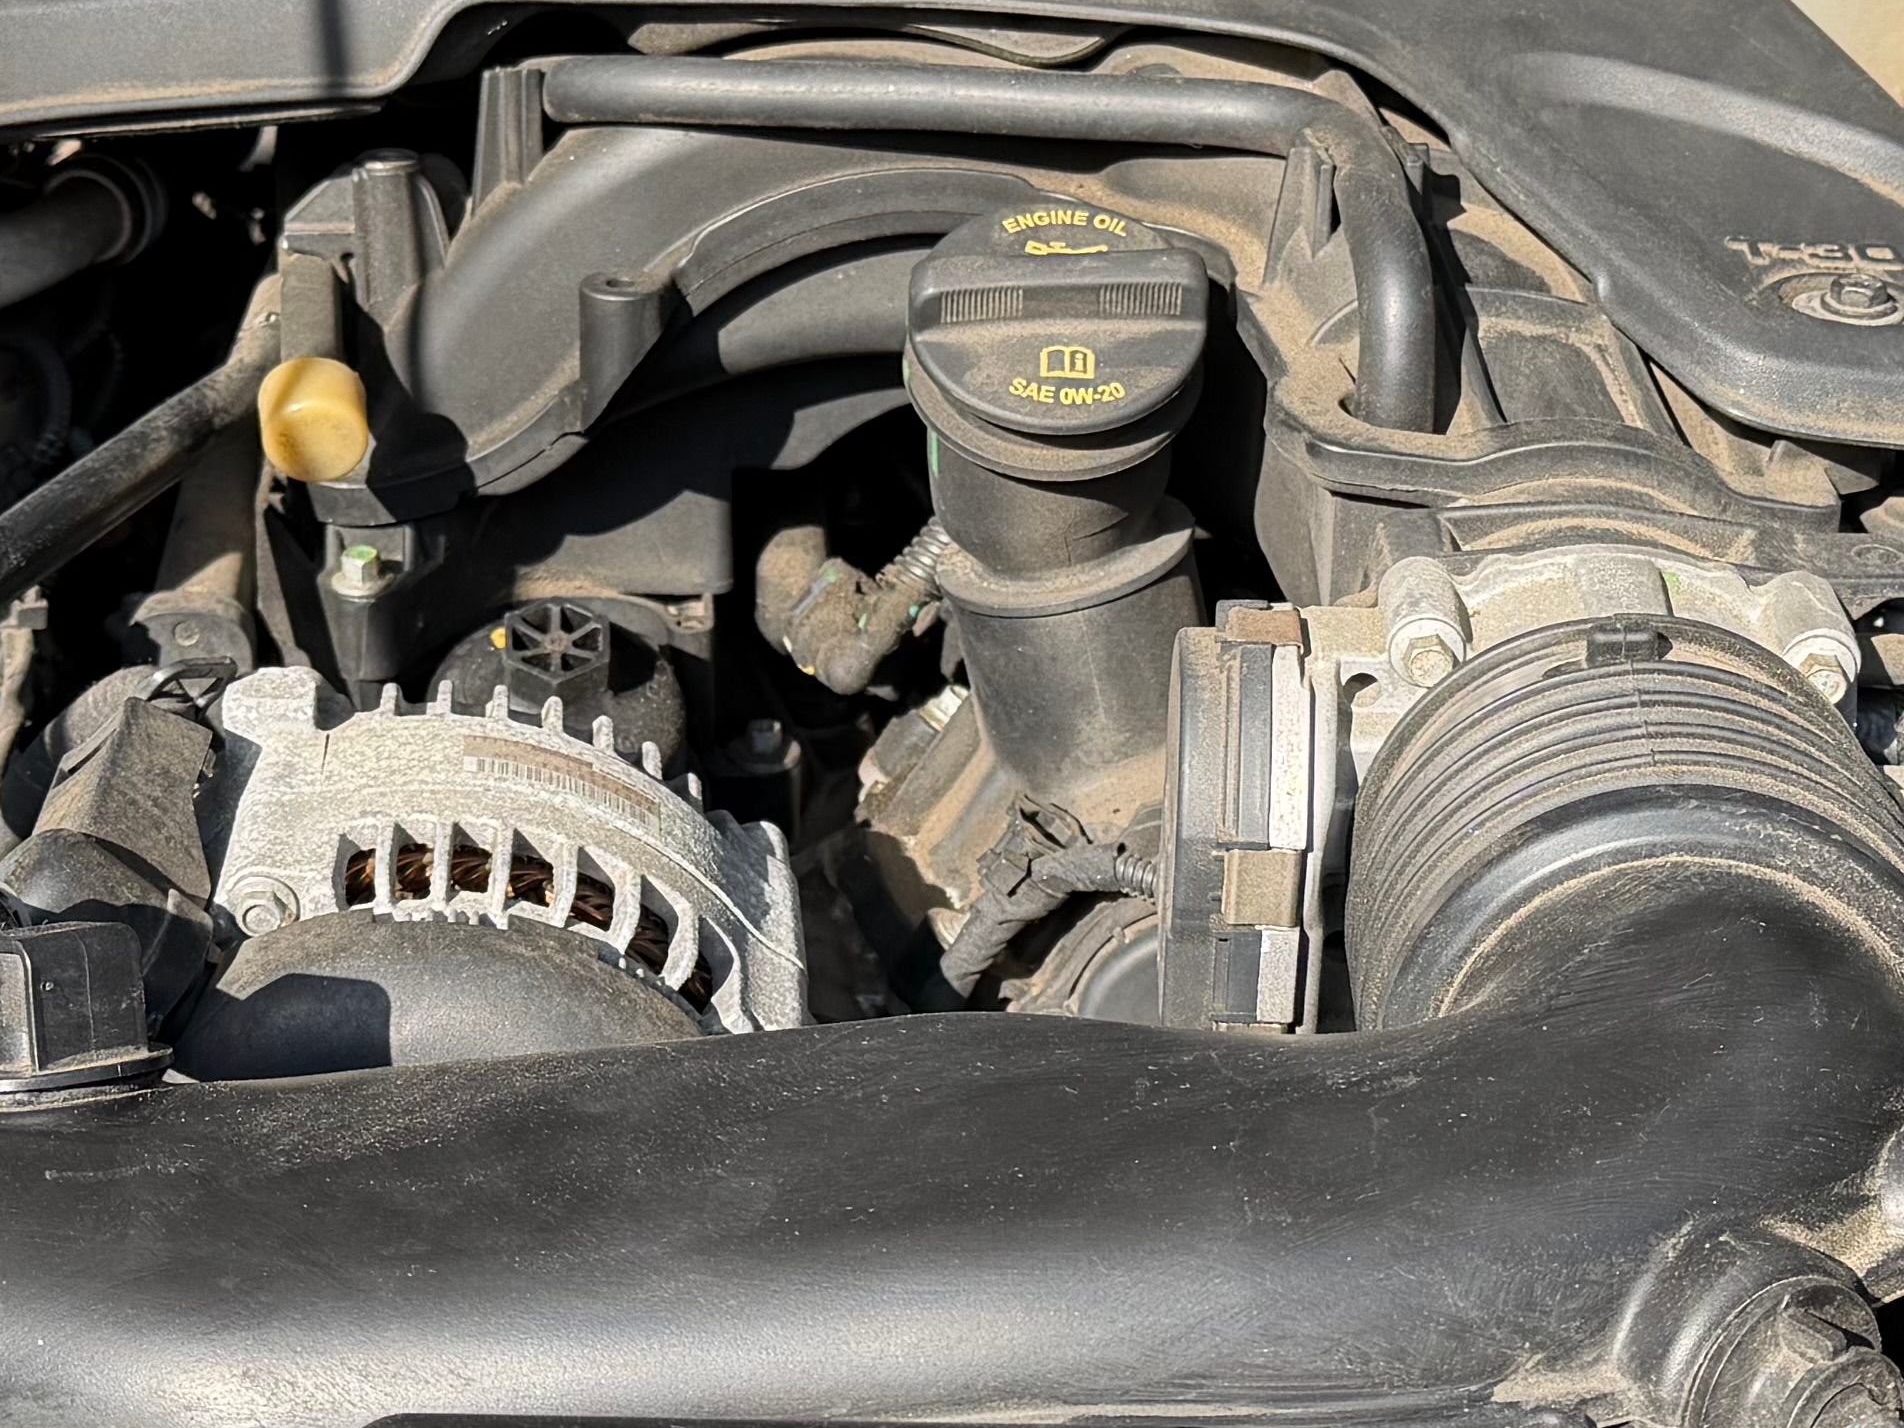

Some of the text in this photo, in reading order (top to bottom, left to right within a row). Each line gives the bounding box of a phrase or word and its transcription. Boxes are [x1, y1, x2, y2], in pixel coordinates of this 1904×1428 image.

[1002, 210, 1128, 238] ENGINE OIL
[1009, 378, 1126, 405] SAE 0W-20
